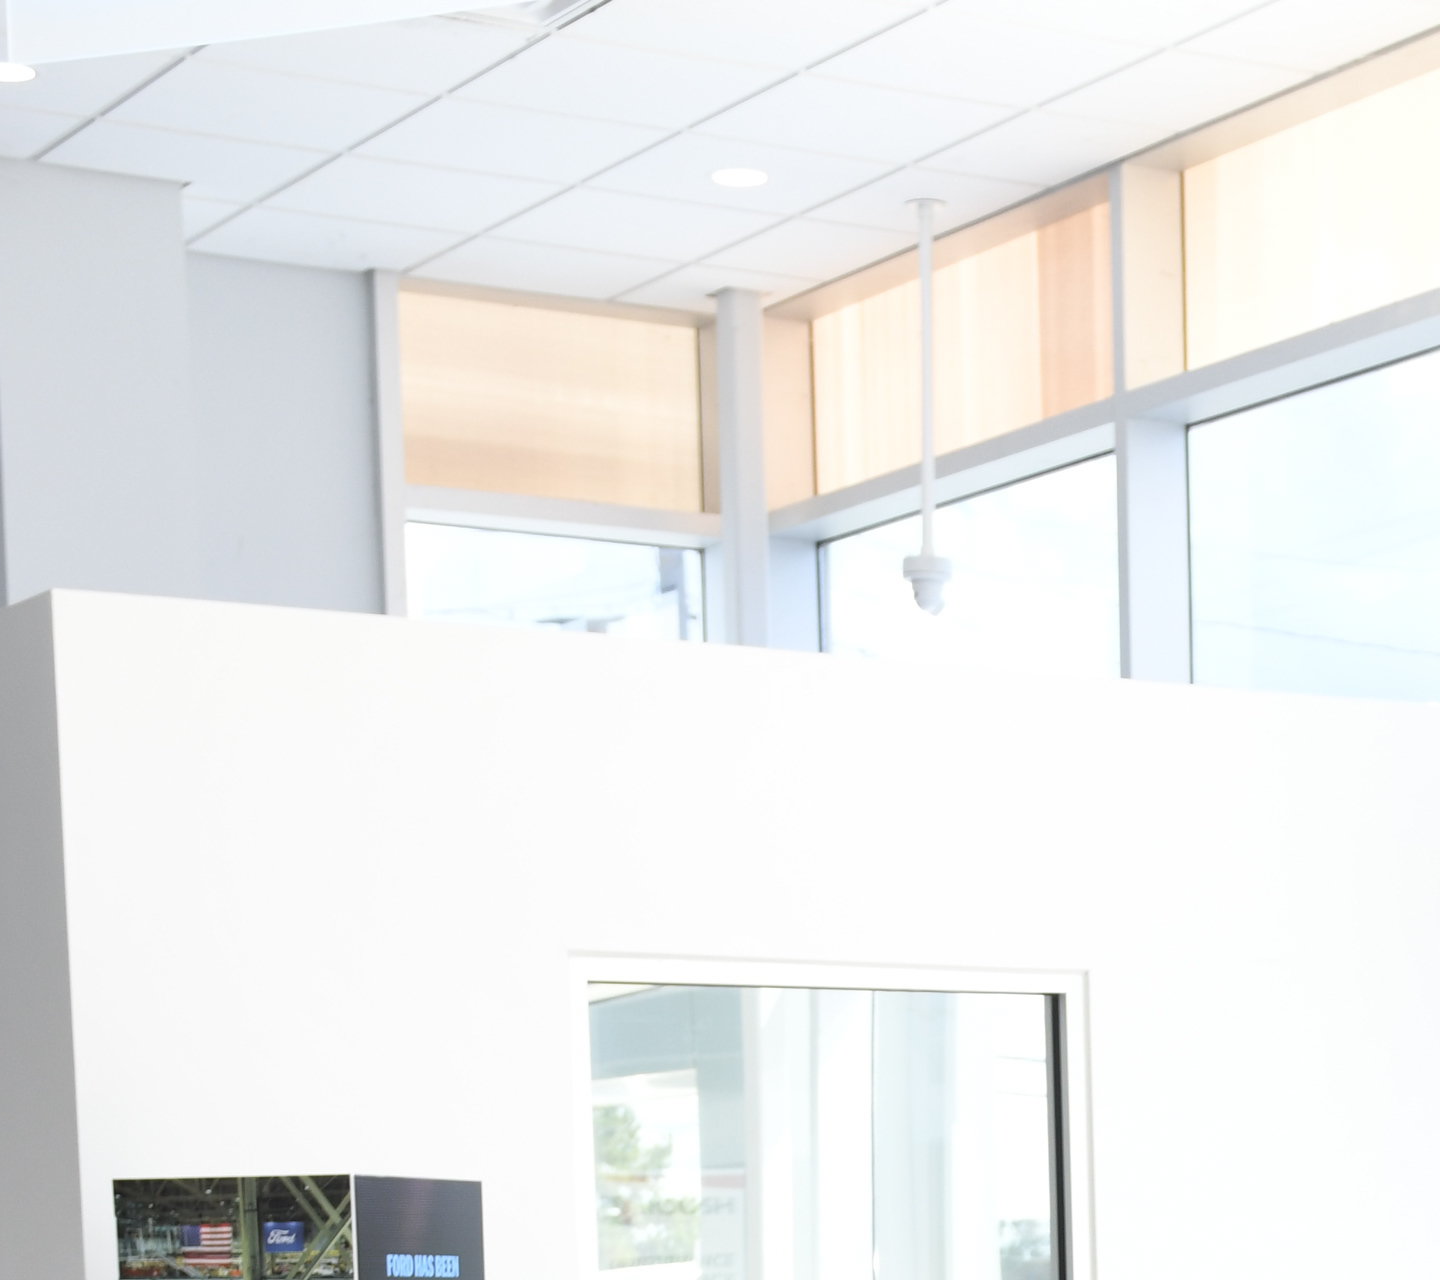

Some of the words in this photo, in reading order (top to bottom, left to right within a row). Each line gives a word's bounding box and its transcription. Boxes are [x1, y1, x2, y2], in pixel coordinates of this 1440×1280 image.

[266, 1228, 297, 1246] Ford
[386, 1254, 413, 1277] FORD
[414, 1254, 435, 1278] HAS
[435, 1255, 460, 1278] BEEN
